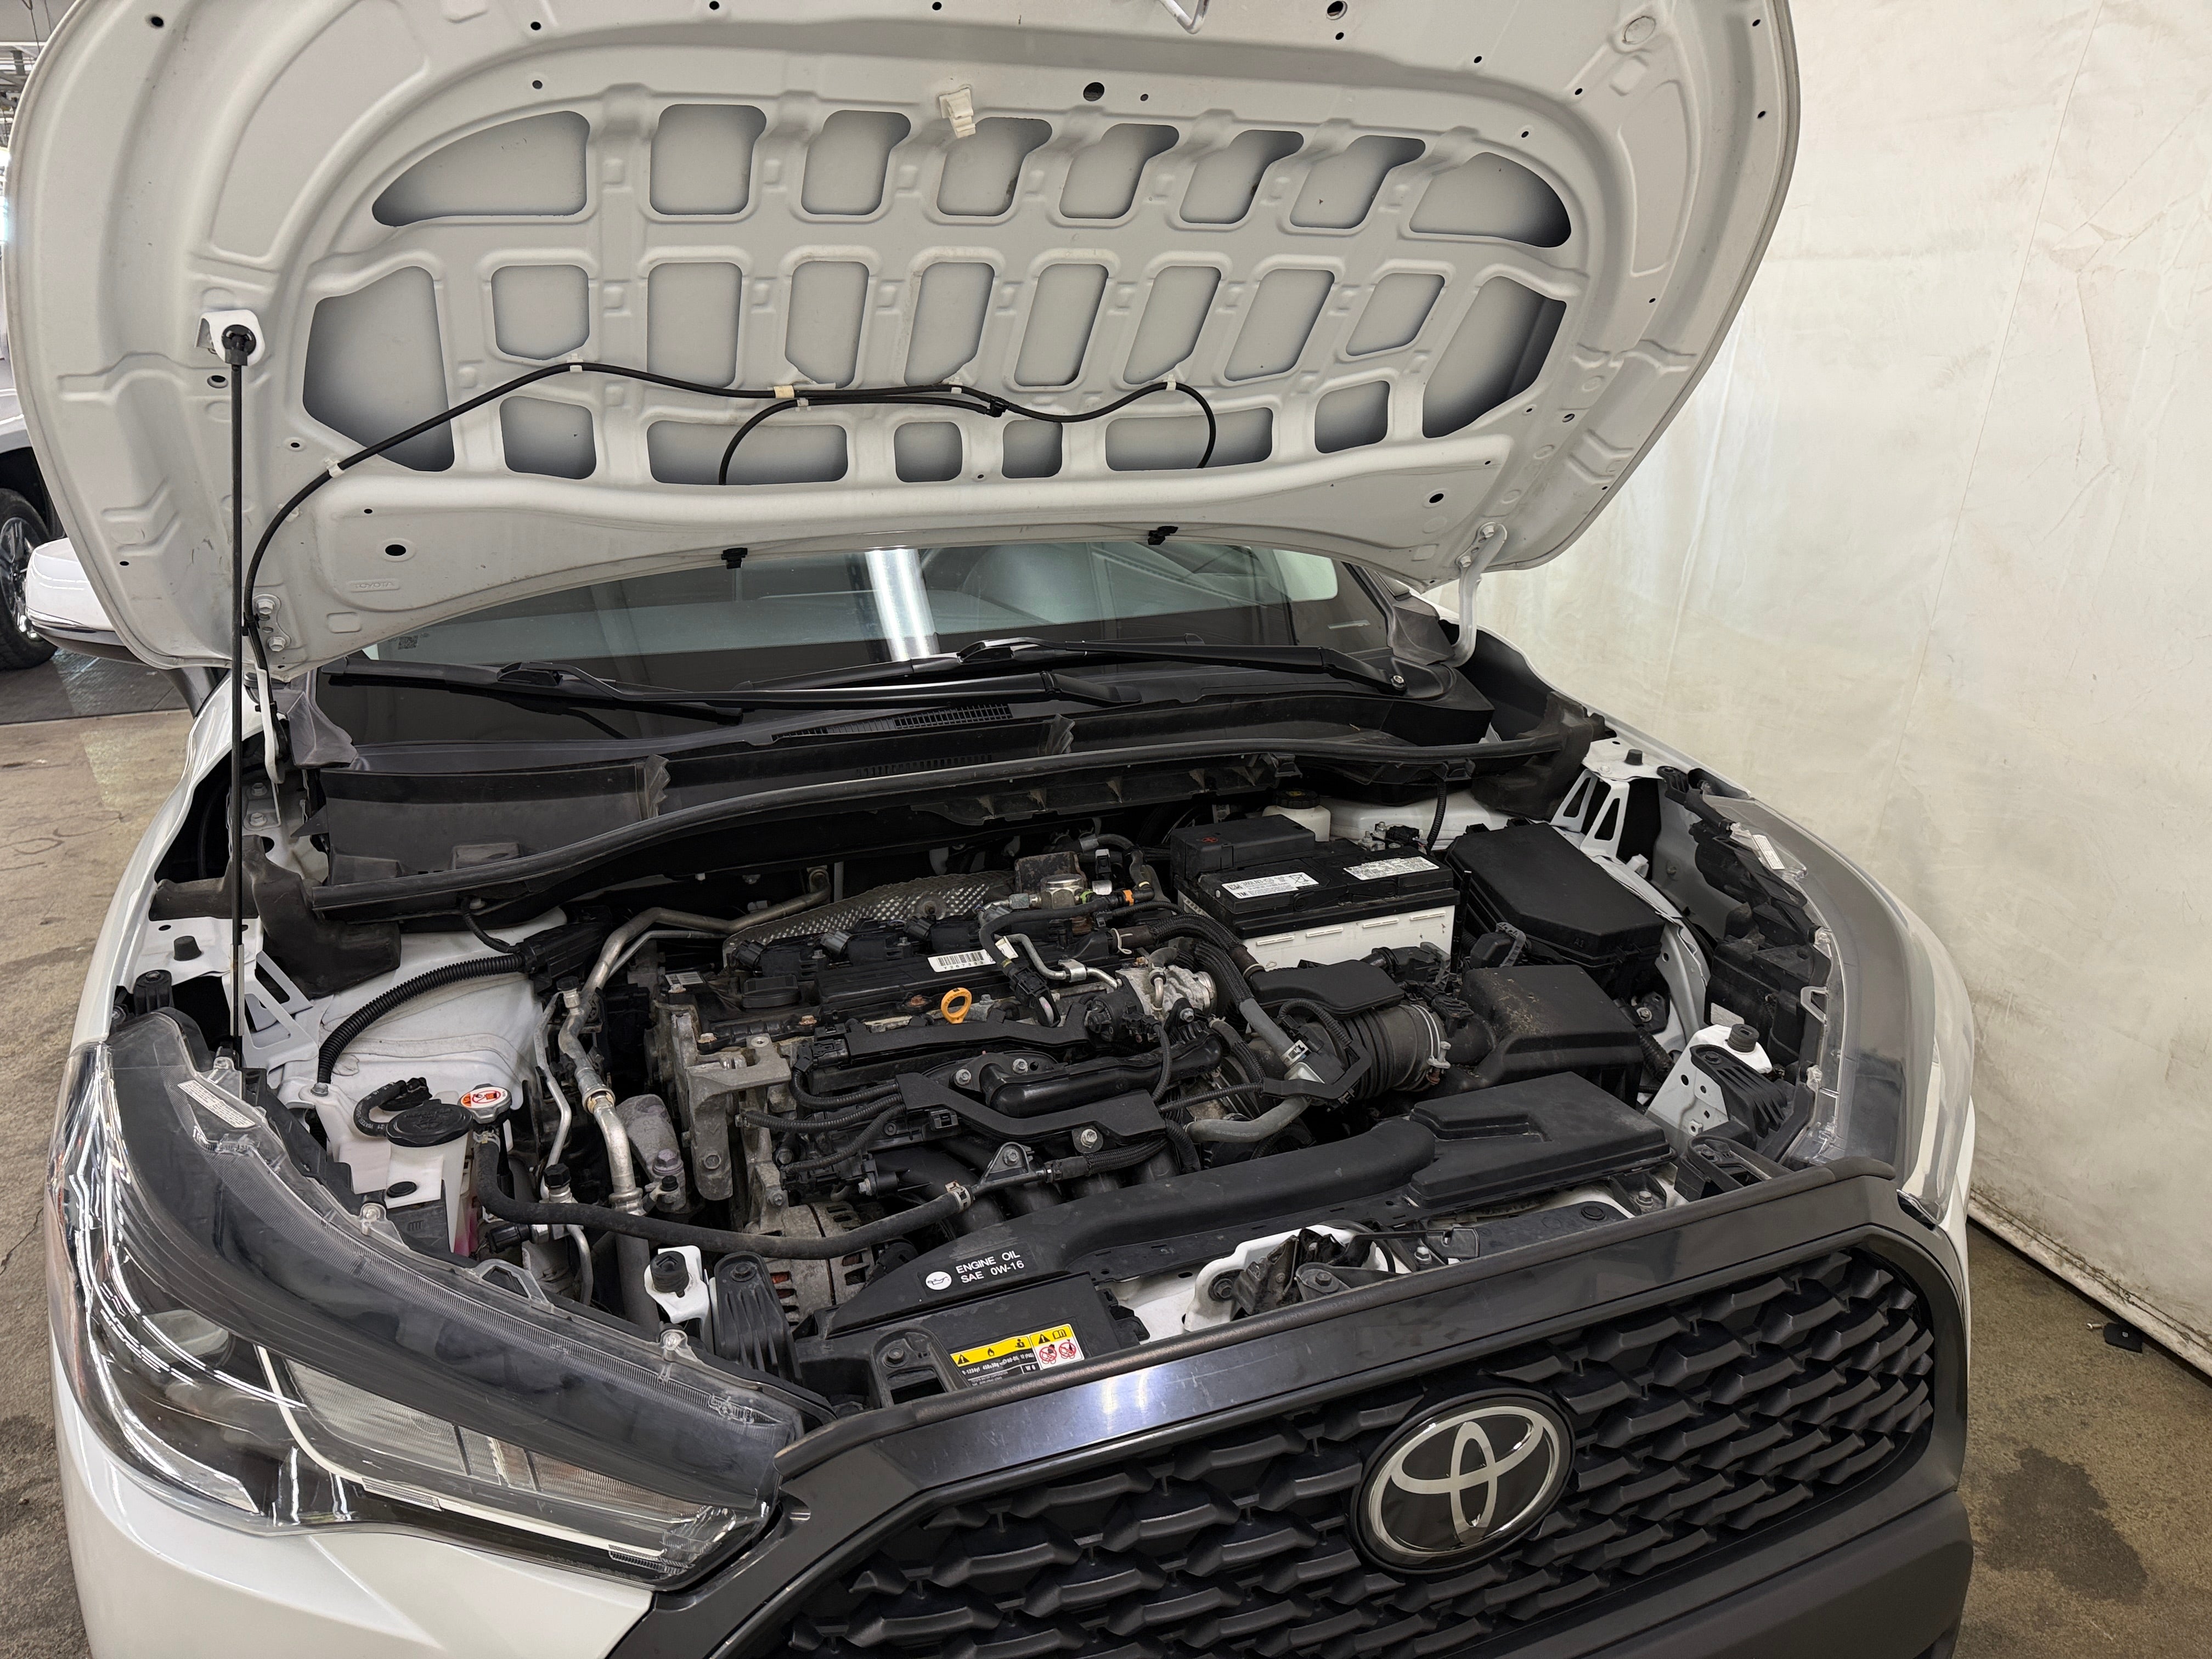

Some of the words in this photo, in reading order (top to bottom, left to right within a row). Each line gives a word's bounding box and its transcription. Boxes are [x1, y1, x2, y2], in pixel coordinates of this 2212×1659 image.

[956, 1256, 996, 1274] ENGINE
[1002, 1251, 1020, 1261] OIL
[961, 1271, 984, 1283] SAE
[990, 1260, 1024, 1275] 0W-16
